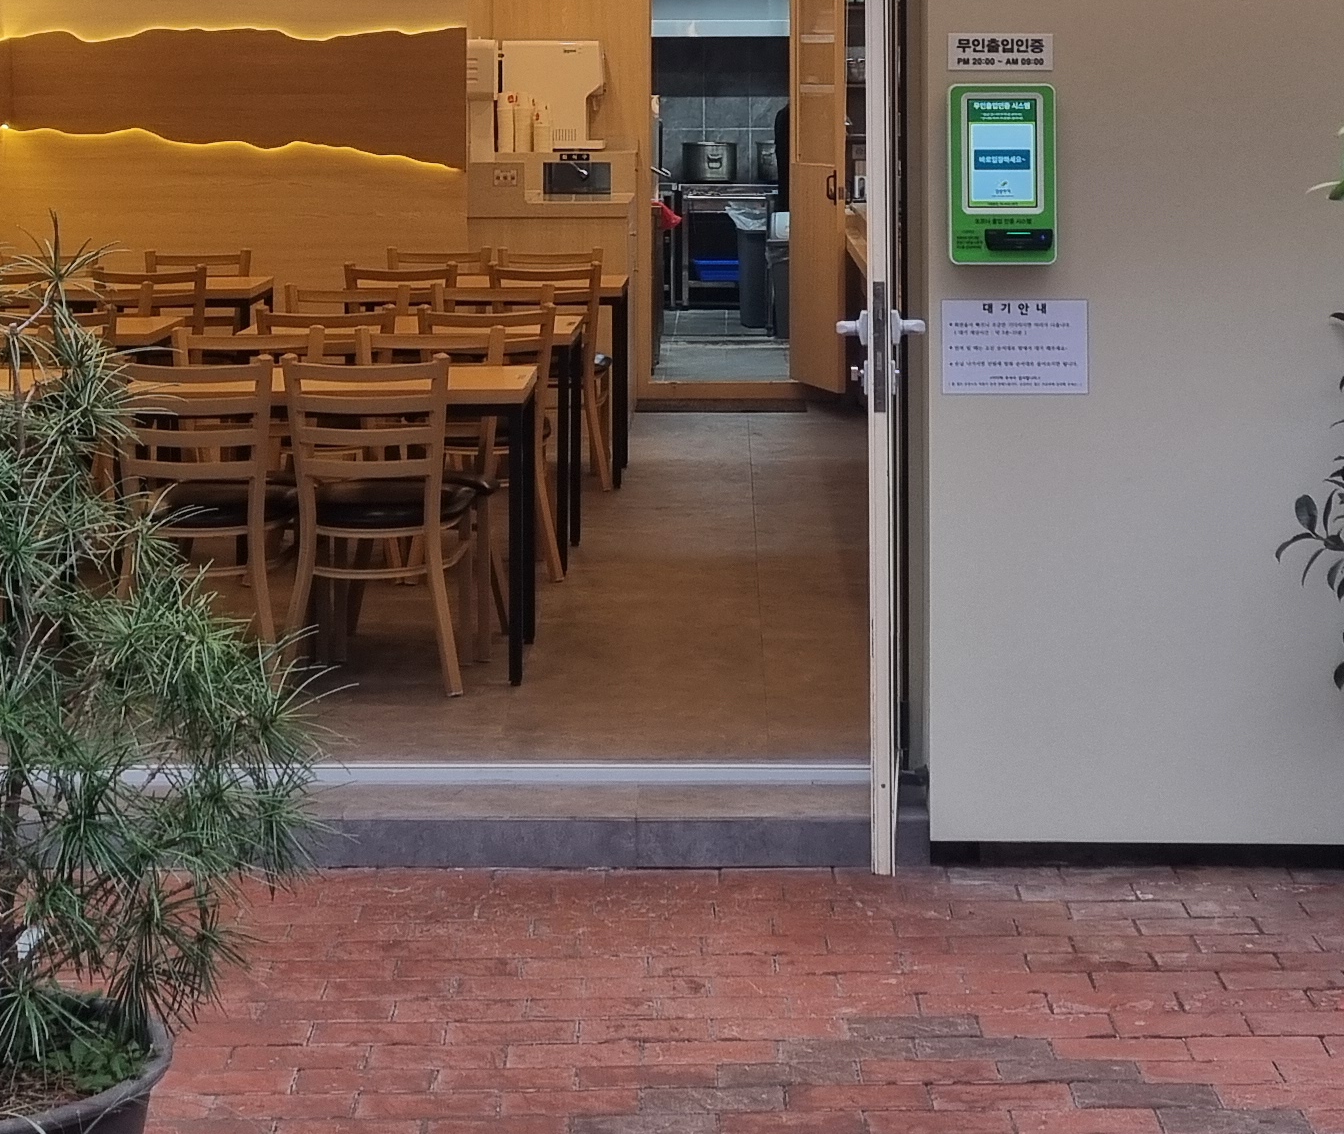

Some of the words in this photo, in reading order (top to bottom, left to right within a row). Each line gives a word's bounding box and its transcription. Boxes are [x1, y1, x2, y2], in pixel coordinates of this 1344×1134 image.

[956, 37, 1045, 54] 무인출입인증
[957, 57, 970, 66] PM
[972, 57, 996, 66] 20:00
[1005, 57, 1019, 66] AM
